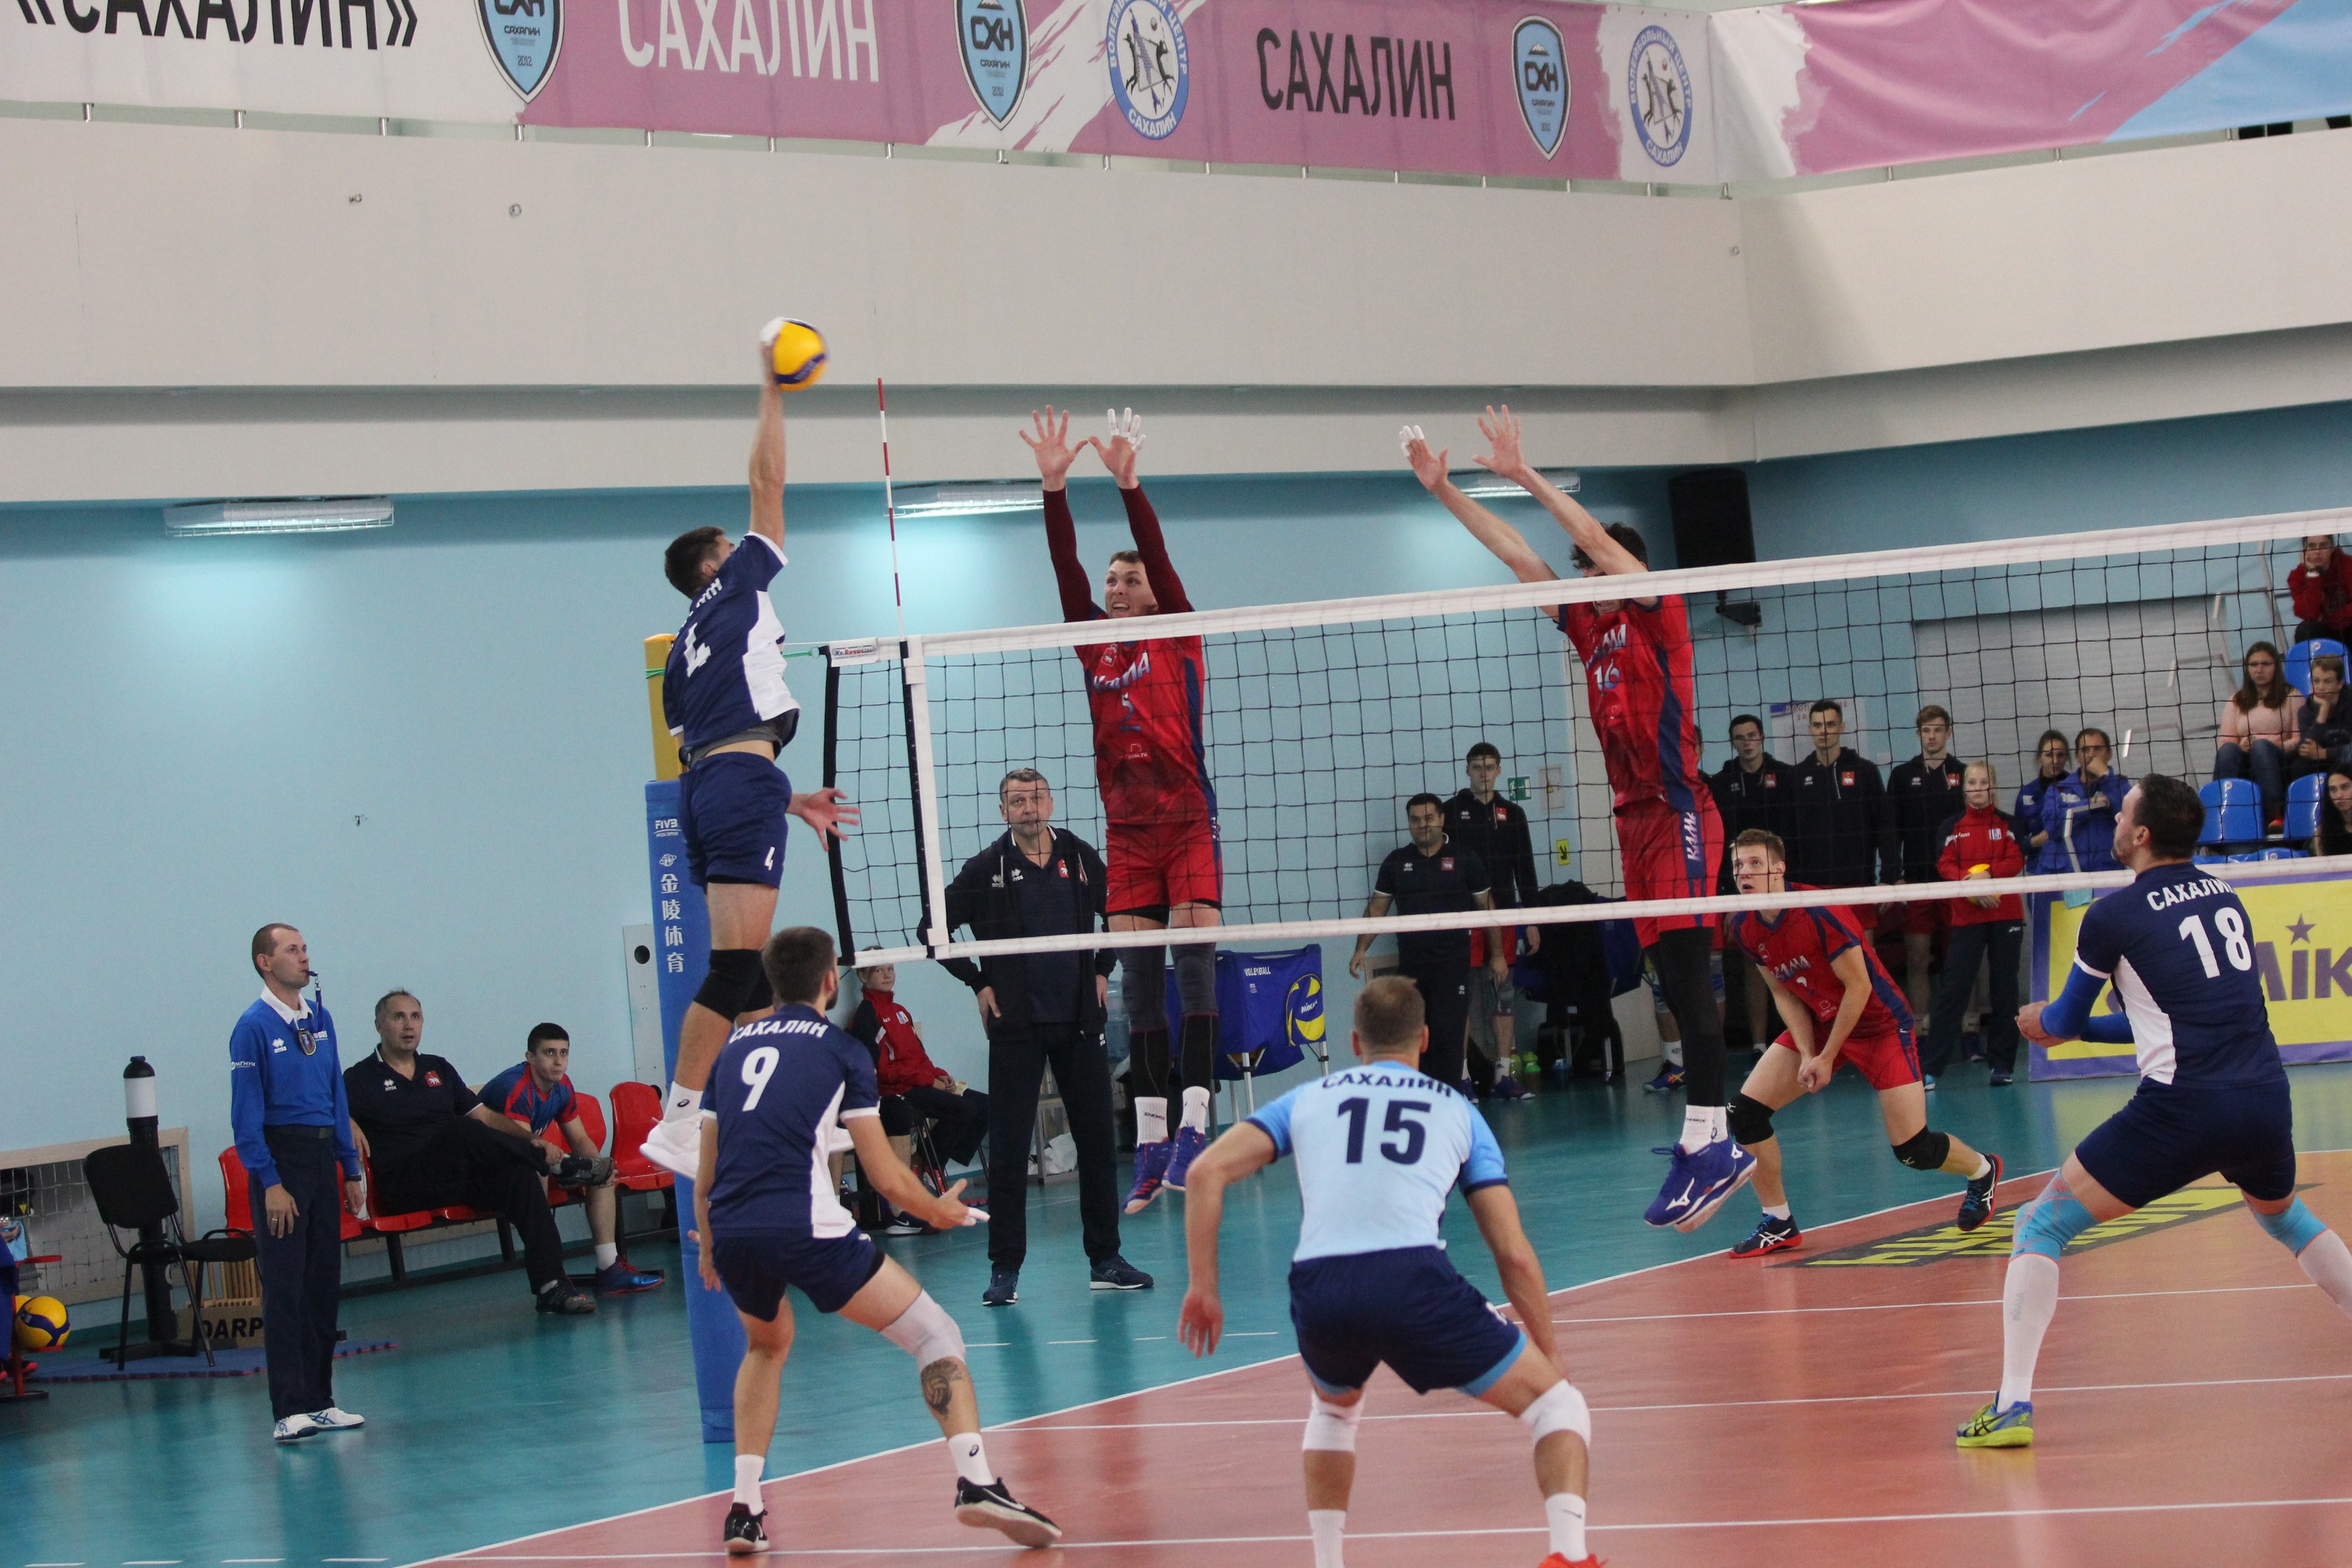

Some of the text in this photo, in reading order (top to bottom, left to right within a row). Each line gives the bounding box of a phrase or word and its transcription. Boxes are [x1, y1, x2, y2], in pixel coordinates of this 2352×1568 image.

[518, 56, 533, 66] 2012
[618, 0, 879, 82] САХАЛИН
[1168, 12, 1188, 75] ЦЕНТР
[1257, 27, 1455, 121] САХАЛИН
[1128, 108, 1177, 136] САХАЛИН
[1646, 139, 1683, 164] САХАЛИН
[684, 622, 711, 678] 4
[1594, 658, 1620, 693] 16
[764, 846, 775, 871] 4
[2147, 877, 2237, 910] САХАЛИ
[661, 873, 685, 973] 金陵体育
[2179, 907, 2252, 979] 18
[729, 1019, 829, 1045] САХАЛИН
[741, 1046, 780, 1112] 9
[1322, 1072, 1452, 1098] САХАЛИН
[1338, 1097, 1432, 1165] 15
